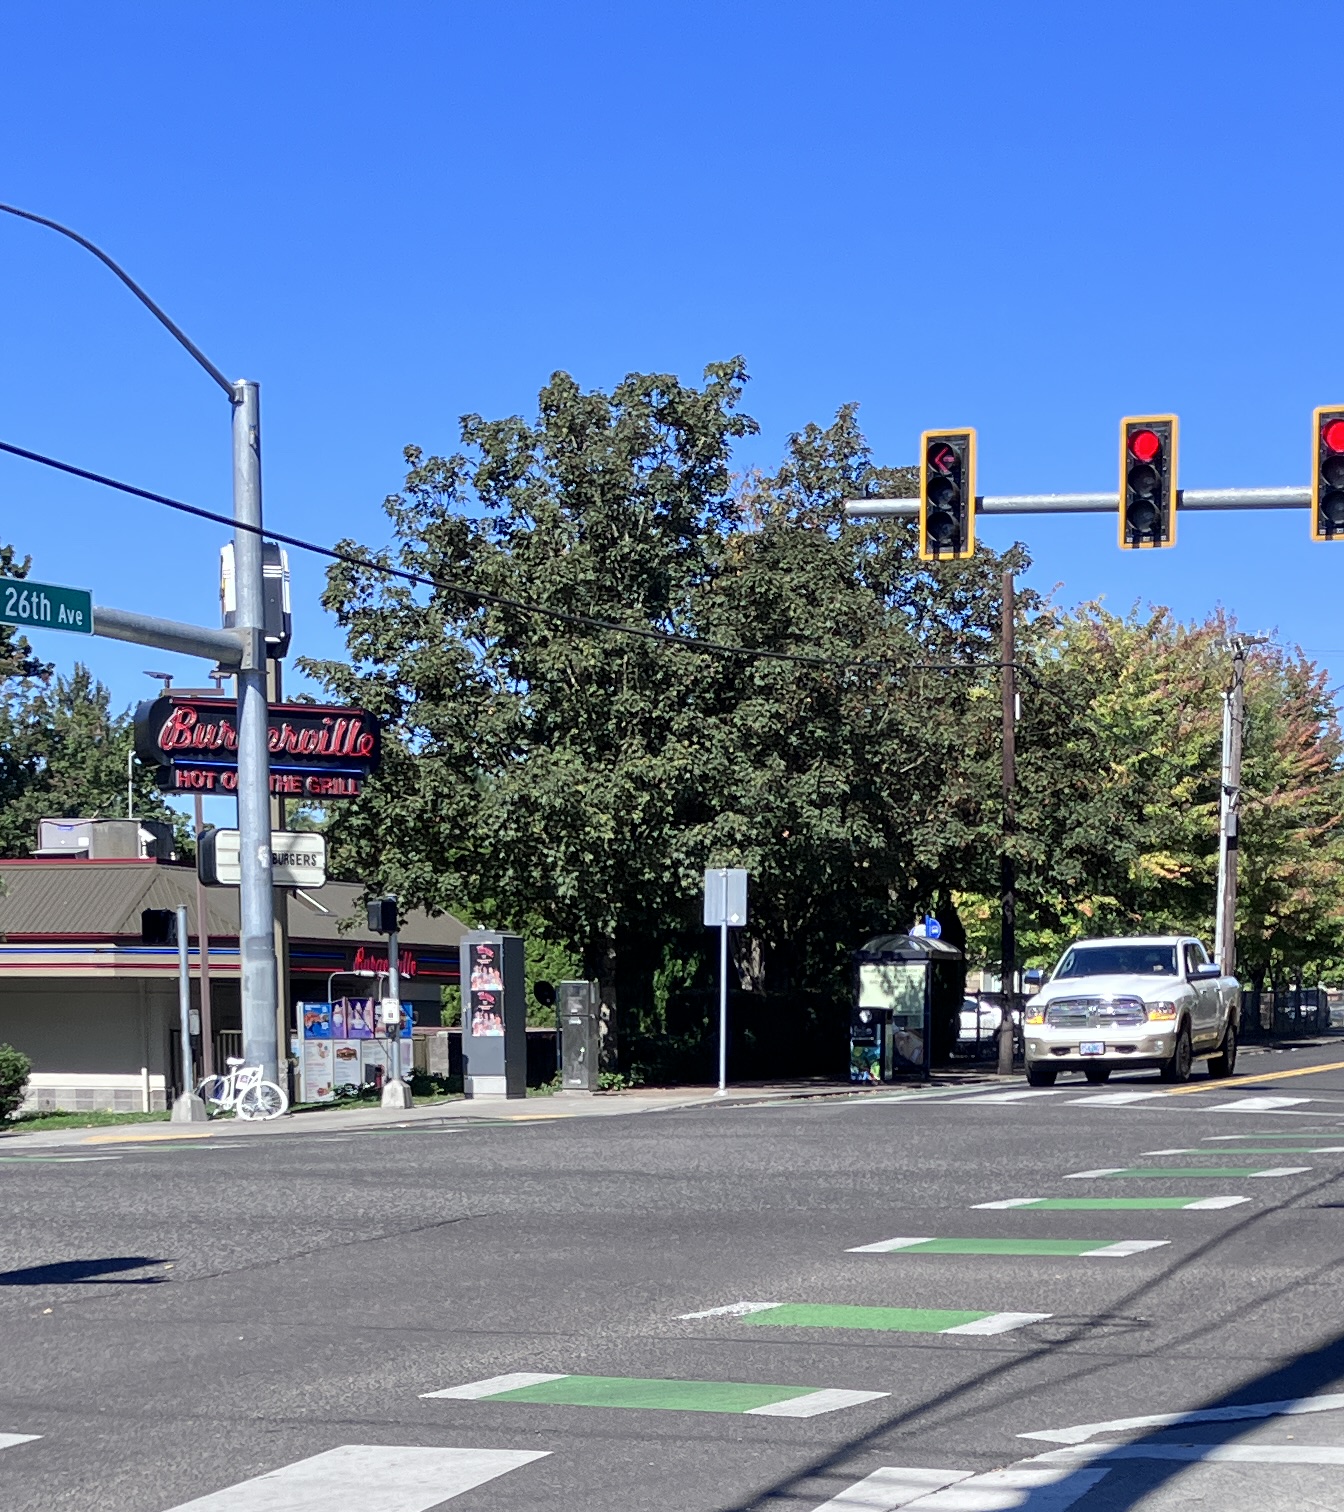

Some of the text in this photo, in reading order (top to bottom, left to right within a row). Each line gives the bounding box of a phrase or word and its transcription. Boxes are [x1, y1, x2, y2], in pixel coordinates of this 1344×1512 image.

[5, 587, 51, 621] 26th
[58, 603, 83, 626] Ave
[158, 706, 375, 757] Burerville
[176, 769, 217, 789] HOT
[268, 774, 303, 793] THE
[306, 775, 361, 795] GRILL
